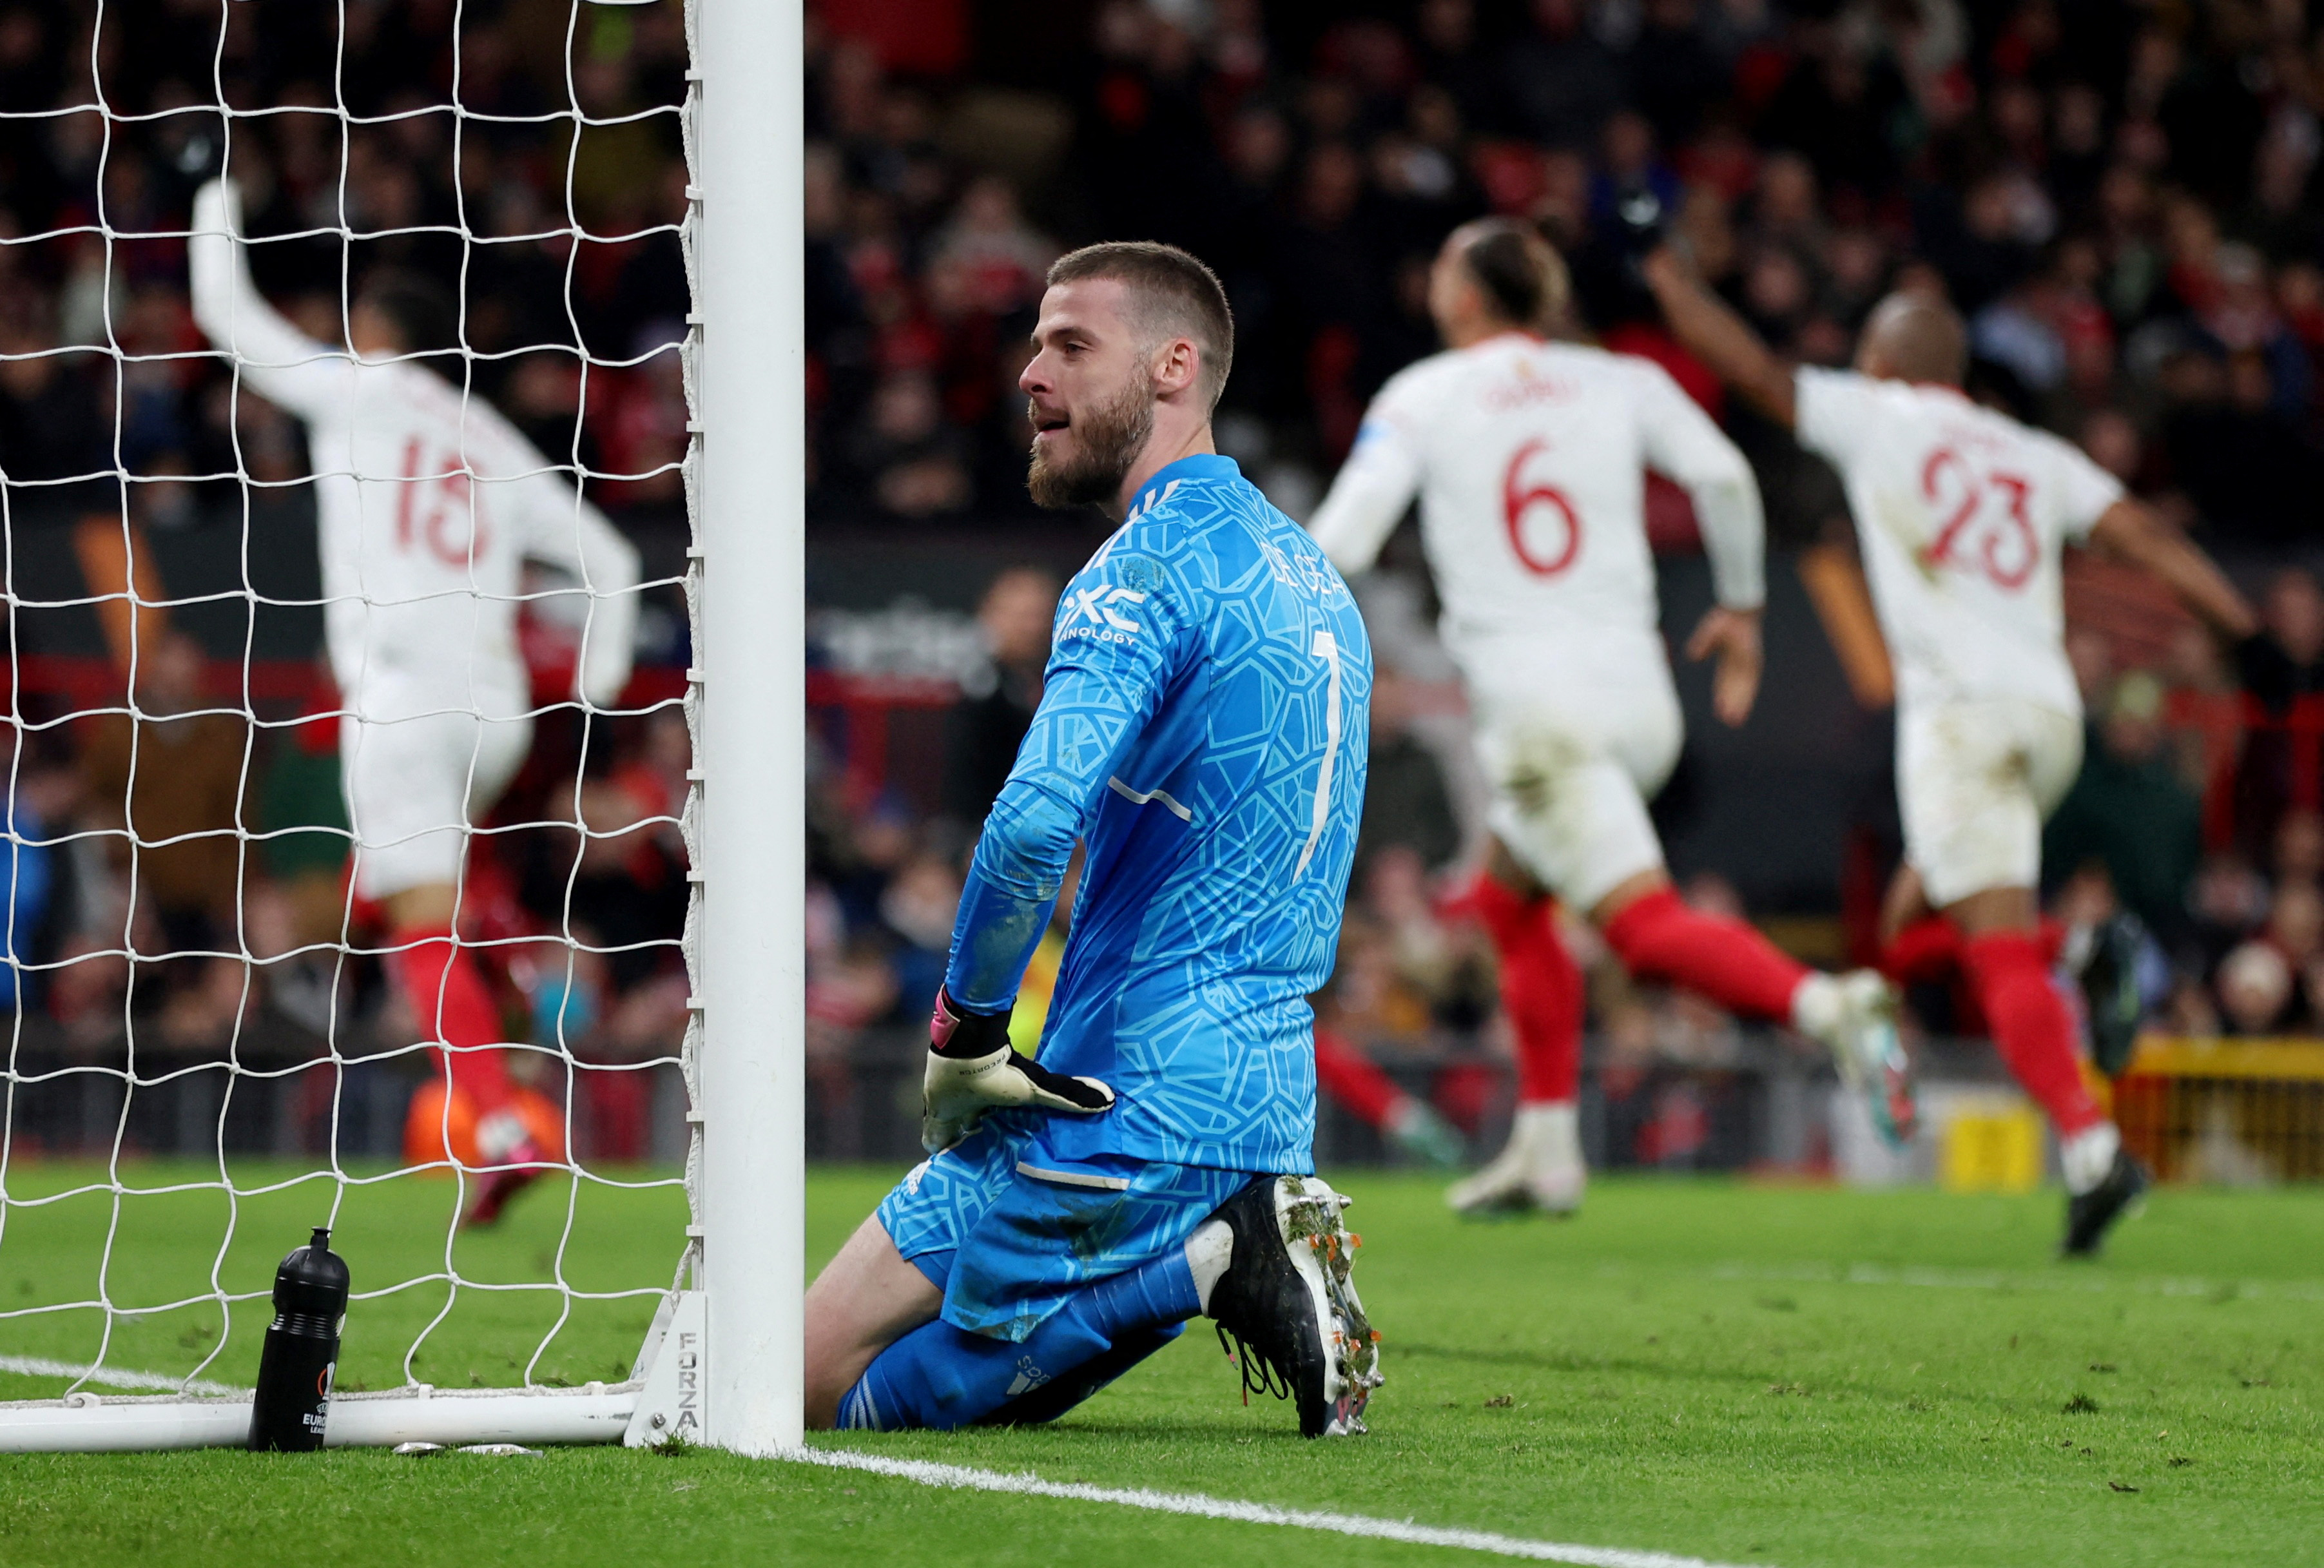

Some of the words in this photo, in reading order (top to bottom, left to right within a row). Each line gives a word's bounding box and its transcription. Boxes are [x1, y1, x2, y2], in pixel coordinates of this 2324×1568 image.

[1260, 541, 1299, 588] DE
[1293, 554, 1346, 594] GEA
[1499, 437, 1583, 580] 6
[1921, 446, 2039, 593] 23
[1291, 630, 1341, 885] 1
[959, 1053, 1006, 1076] PREDATOR
[677, 1333, 698, 1428] FORZA
